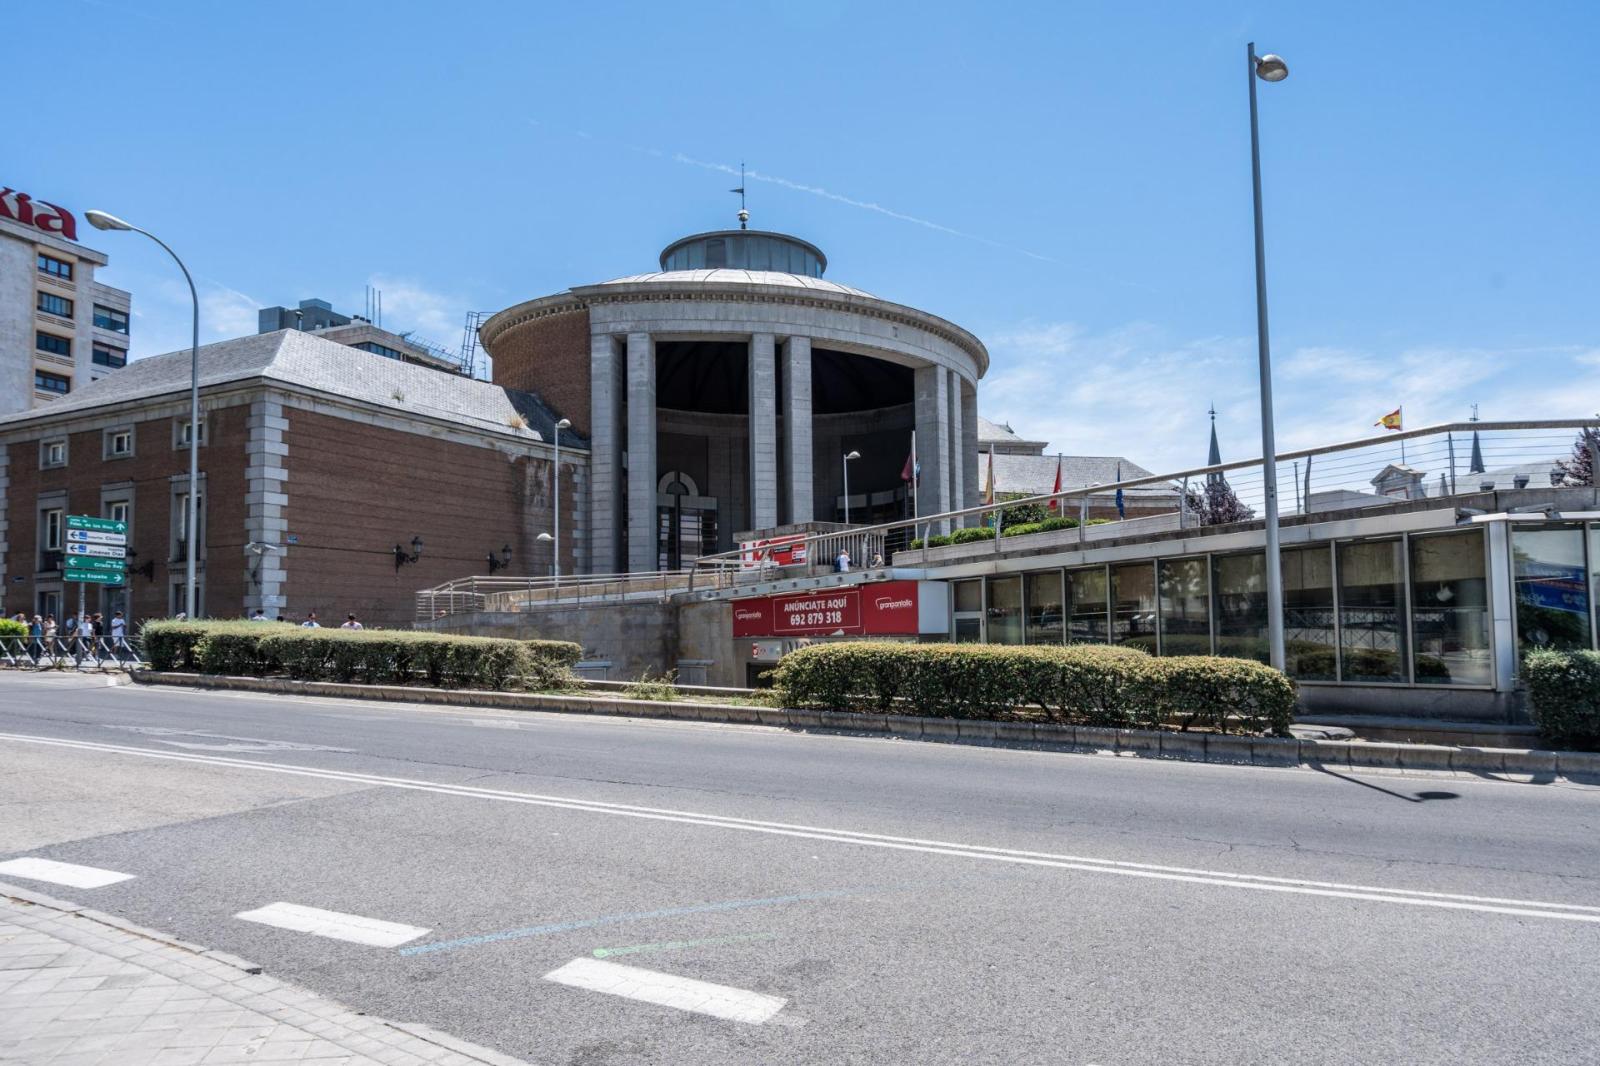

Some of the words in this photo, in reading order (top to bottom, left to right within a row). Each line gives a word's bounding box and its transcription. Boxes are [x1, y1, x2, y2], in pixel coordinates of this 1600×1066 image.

[784, 600, 826, 612] ANÚNCIATE
[827, 596, 847, 609] AQUÍ
[790, 613, 806, 625] 692
[807, 612, 824, 625] 879
[825, 611, 842, 624] 318
